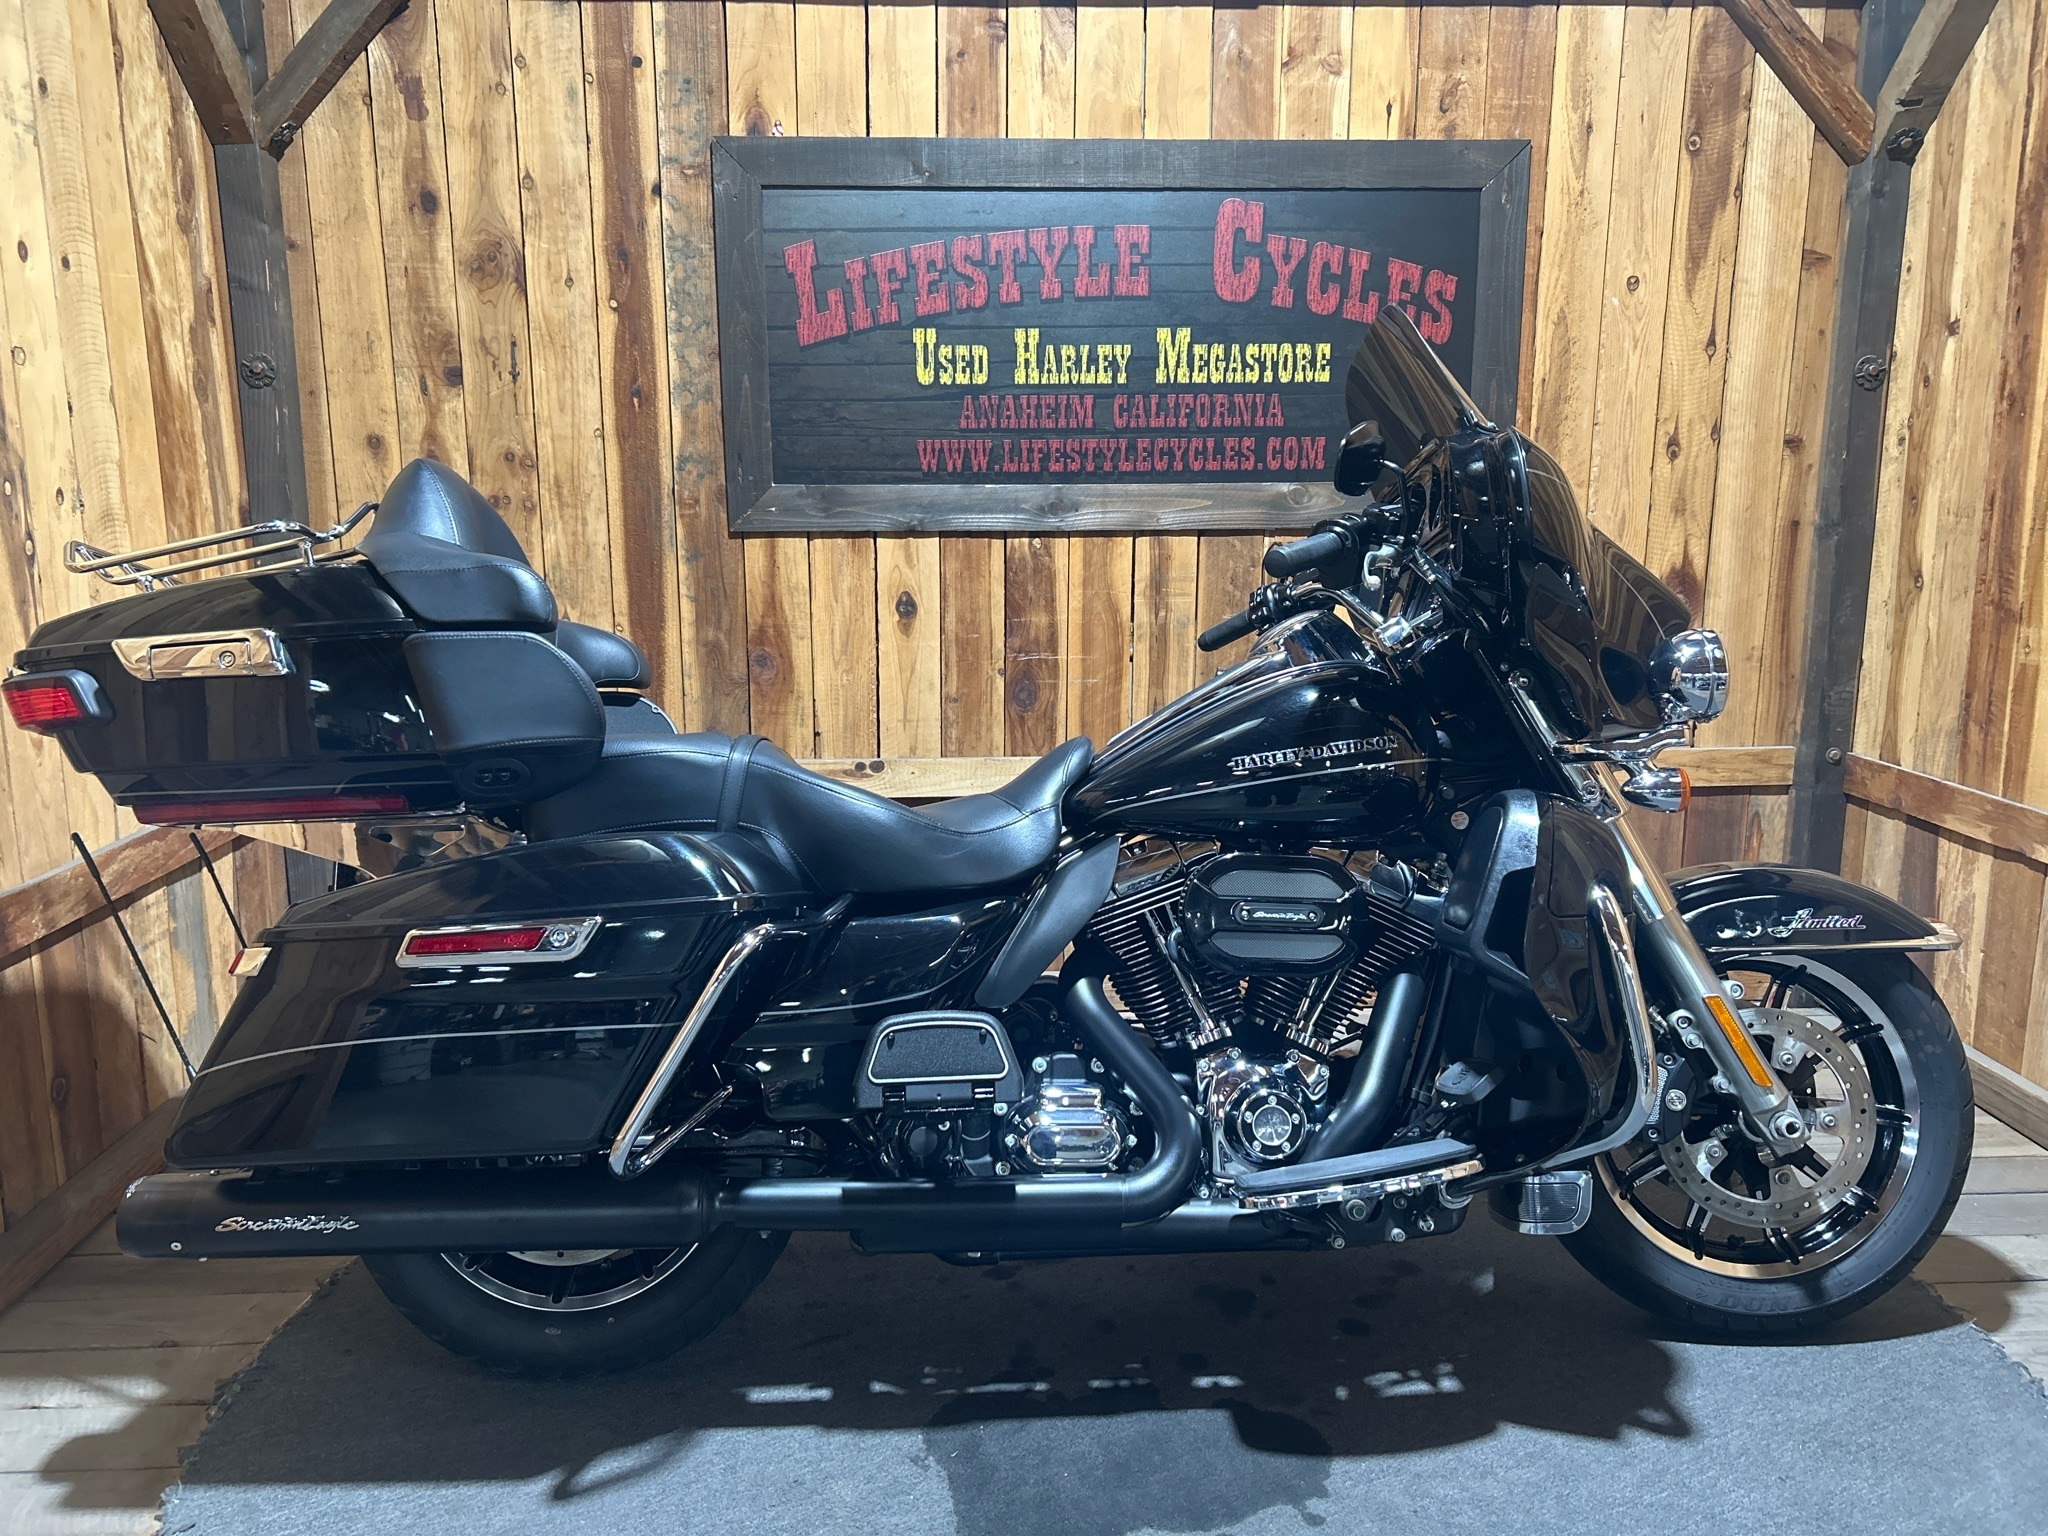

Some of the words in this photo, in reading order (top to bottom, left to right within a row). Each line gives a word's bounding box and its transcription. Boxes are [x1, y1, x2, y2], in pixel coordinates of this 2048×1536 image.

[783, 224, 1150, 347] LIFESTYLE
[1213, 197, 1458, 345] CYCLES
[912, 327, 989, 386] USED
[1013, 327, 1132, 385] HARLEY
[1155, 327, 1331, 384] MEGASTORE
[959, 395, 1094, 429] ANAHEIM
[1112, 393, 1285, 429] CALIFORNIA
[916, 436, 1327, 472] WWW.LIFESTYLECYCLES.COM
[1767, 907, 1867, 938] Limited
